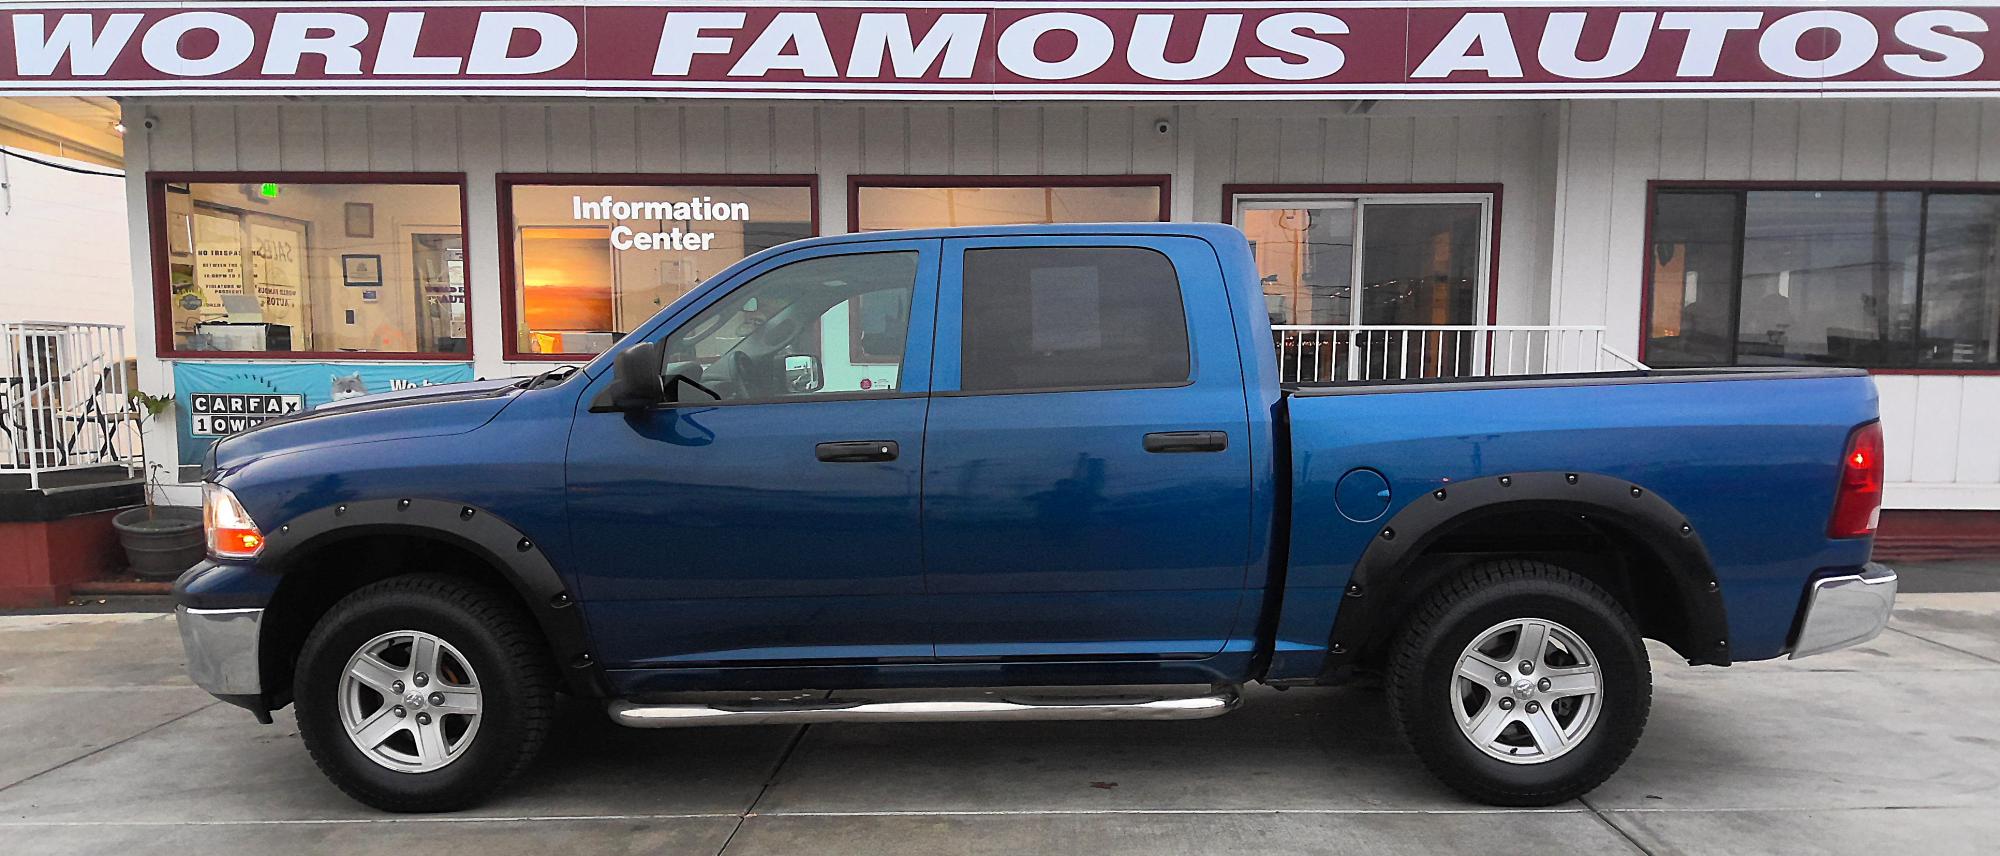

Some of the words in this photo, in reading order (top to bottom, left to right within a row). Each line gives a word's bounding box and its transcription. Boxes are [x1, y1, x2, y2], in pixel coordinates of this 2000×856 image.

[12, 12, 578, 76] WORLD
[652, 12, 1349, 80] FAMOUS
[1410, 10, 1988, 78] AUTOS
[573, 196, 750, 221] Information
[611, 226, 715, 251] Center
[195, 397, 297, 413] CARFAX
